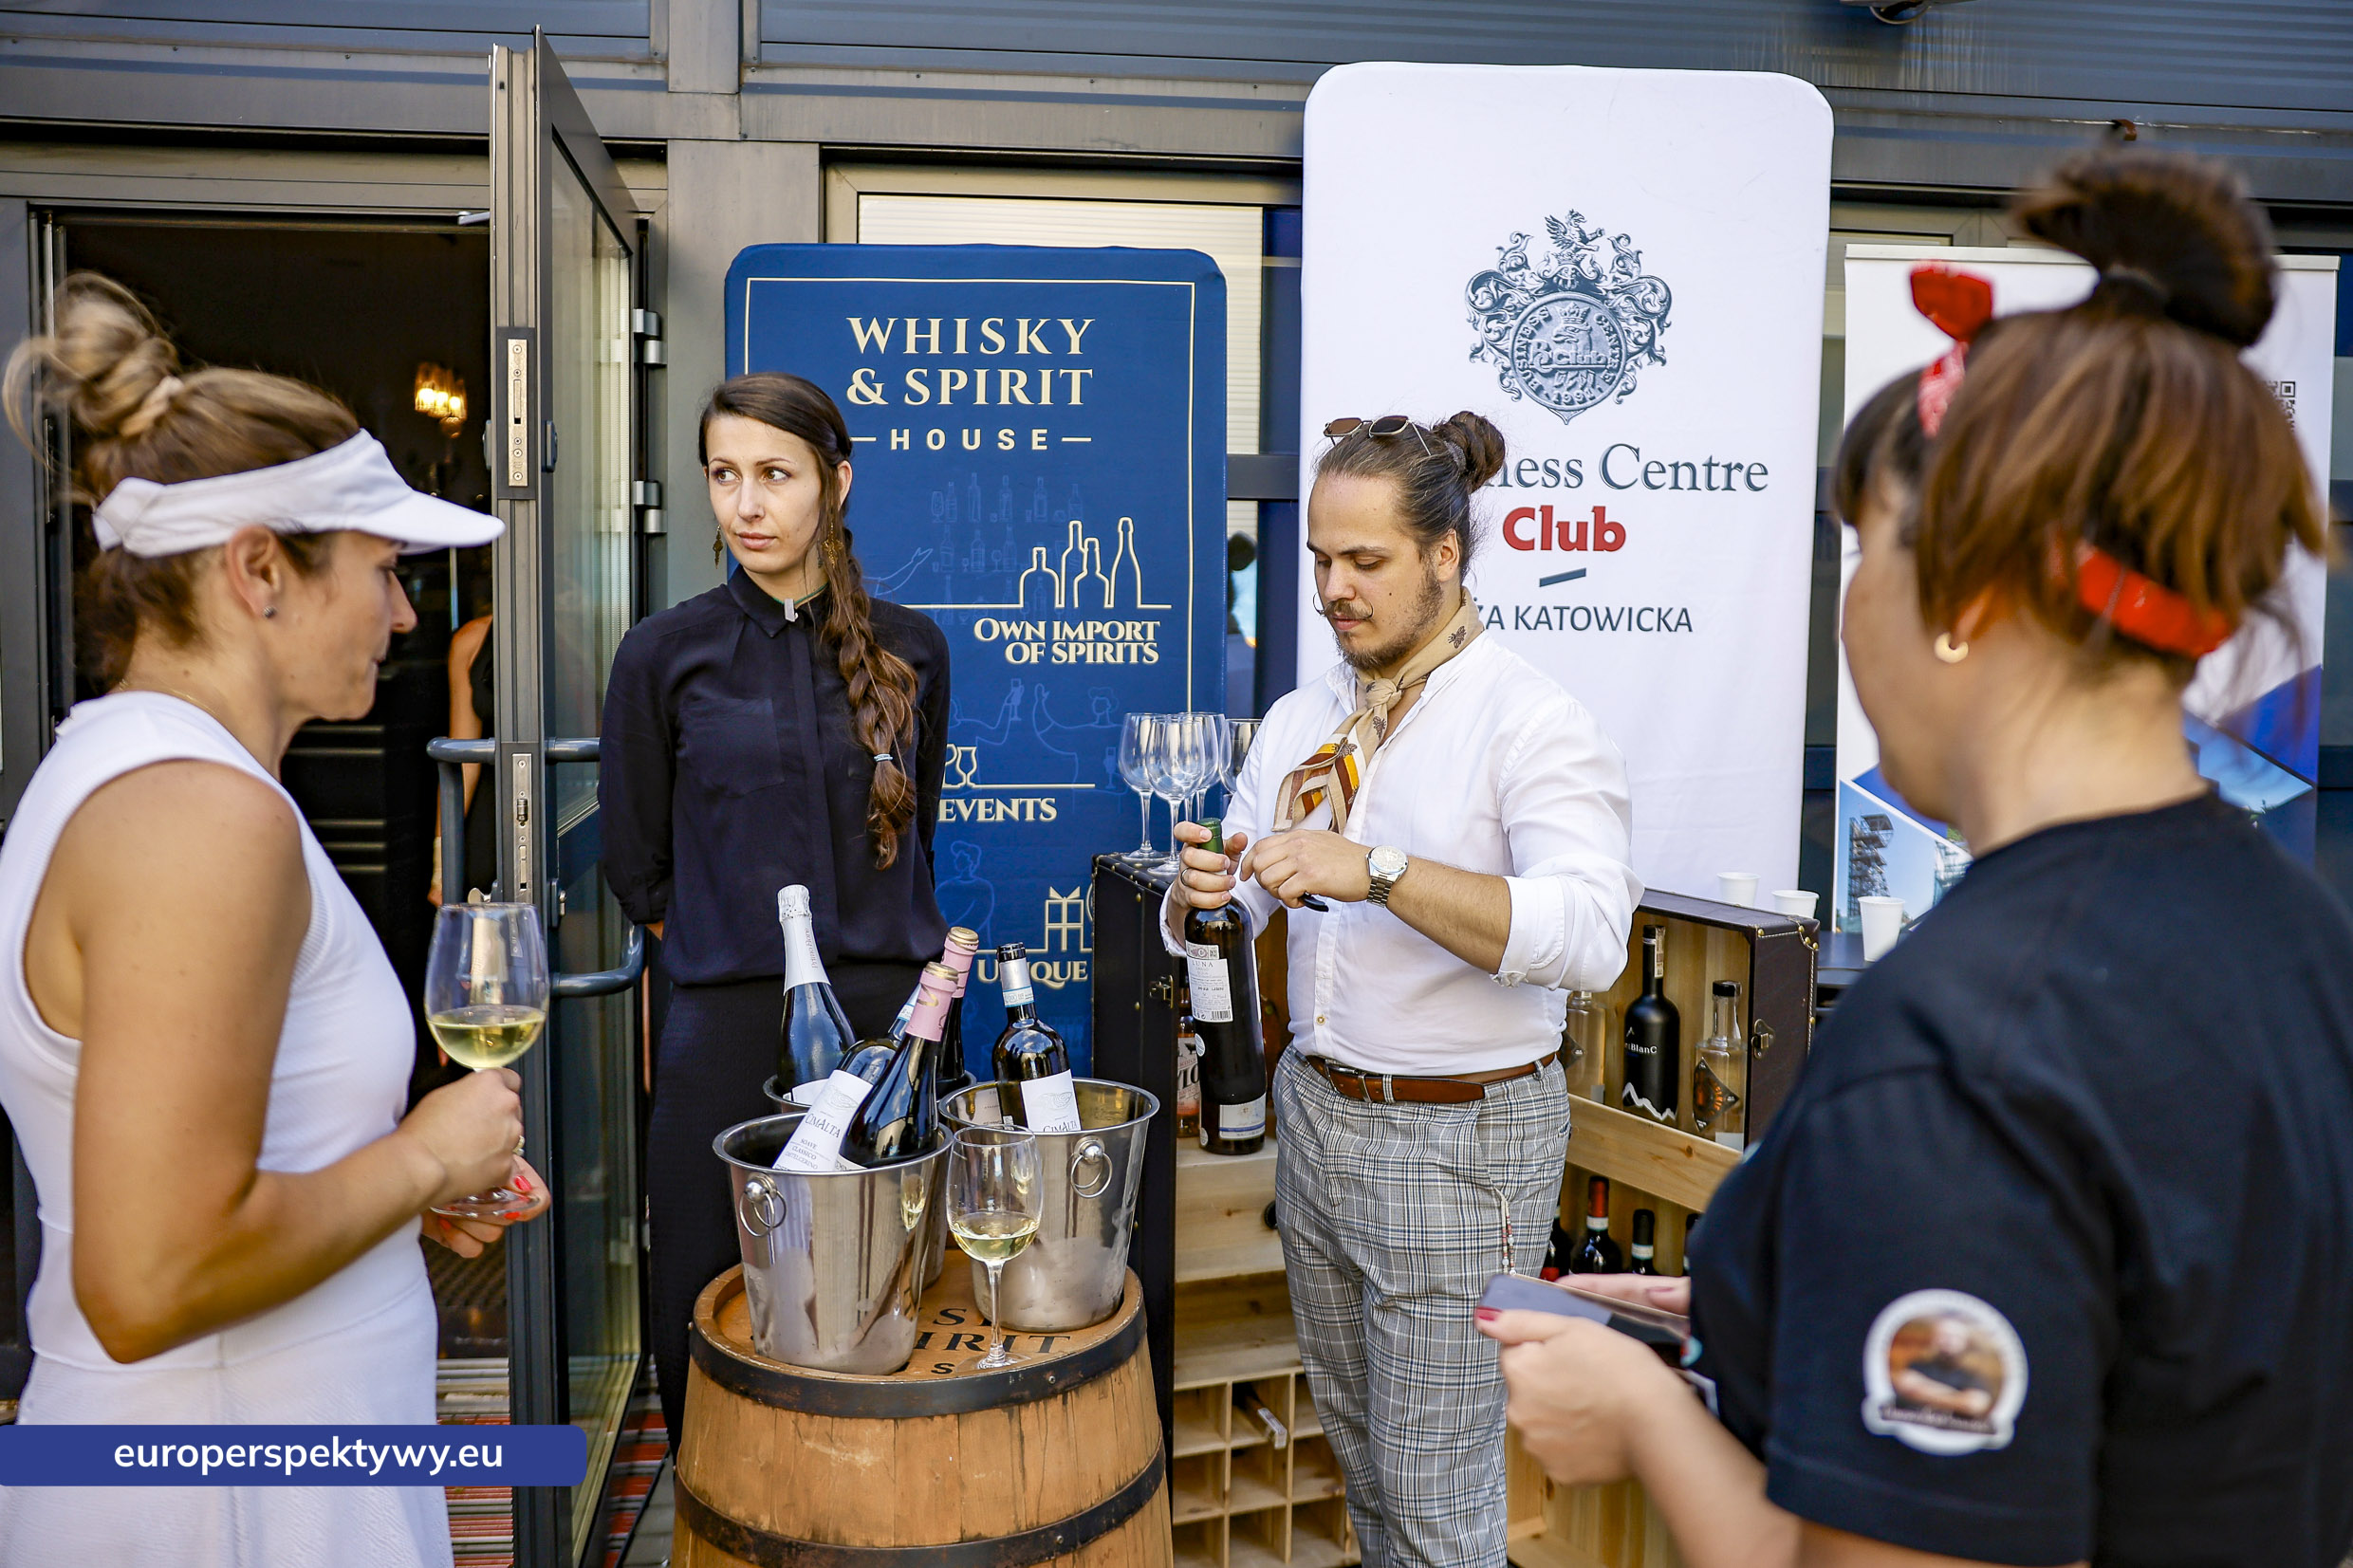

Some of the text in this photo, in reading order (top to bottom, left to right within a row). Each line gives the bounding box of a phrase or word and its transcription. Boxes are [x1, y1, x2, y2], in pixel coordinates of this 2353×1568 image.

[845, 317, 1096, 355] WHISKY
[845, 367, 1094, 406] & SPIRIT
[890, 428, 1049, 451] HOUSE
[1482, 442, 1769, 491] ness Centre
[1502, 504, 1627, 553] Club
[973, 618, 1161, 642] OWN IMPORT
[1514, 604, 1694, 633] KATOWICKA
[1004, 642, 1160, 665] OF SPIRITS
[936, 797, 1058, 822] EVENTS
[977, 959, 1088, 990] UQUE
[805, 1113, 841, 1138] CIMALTA
